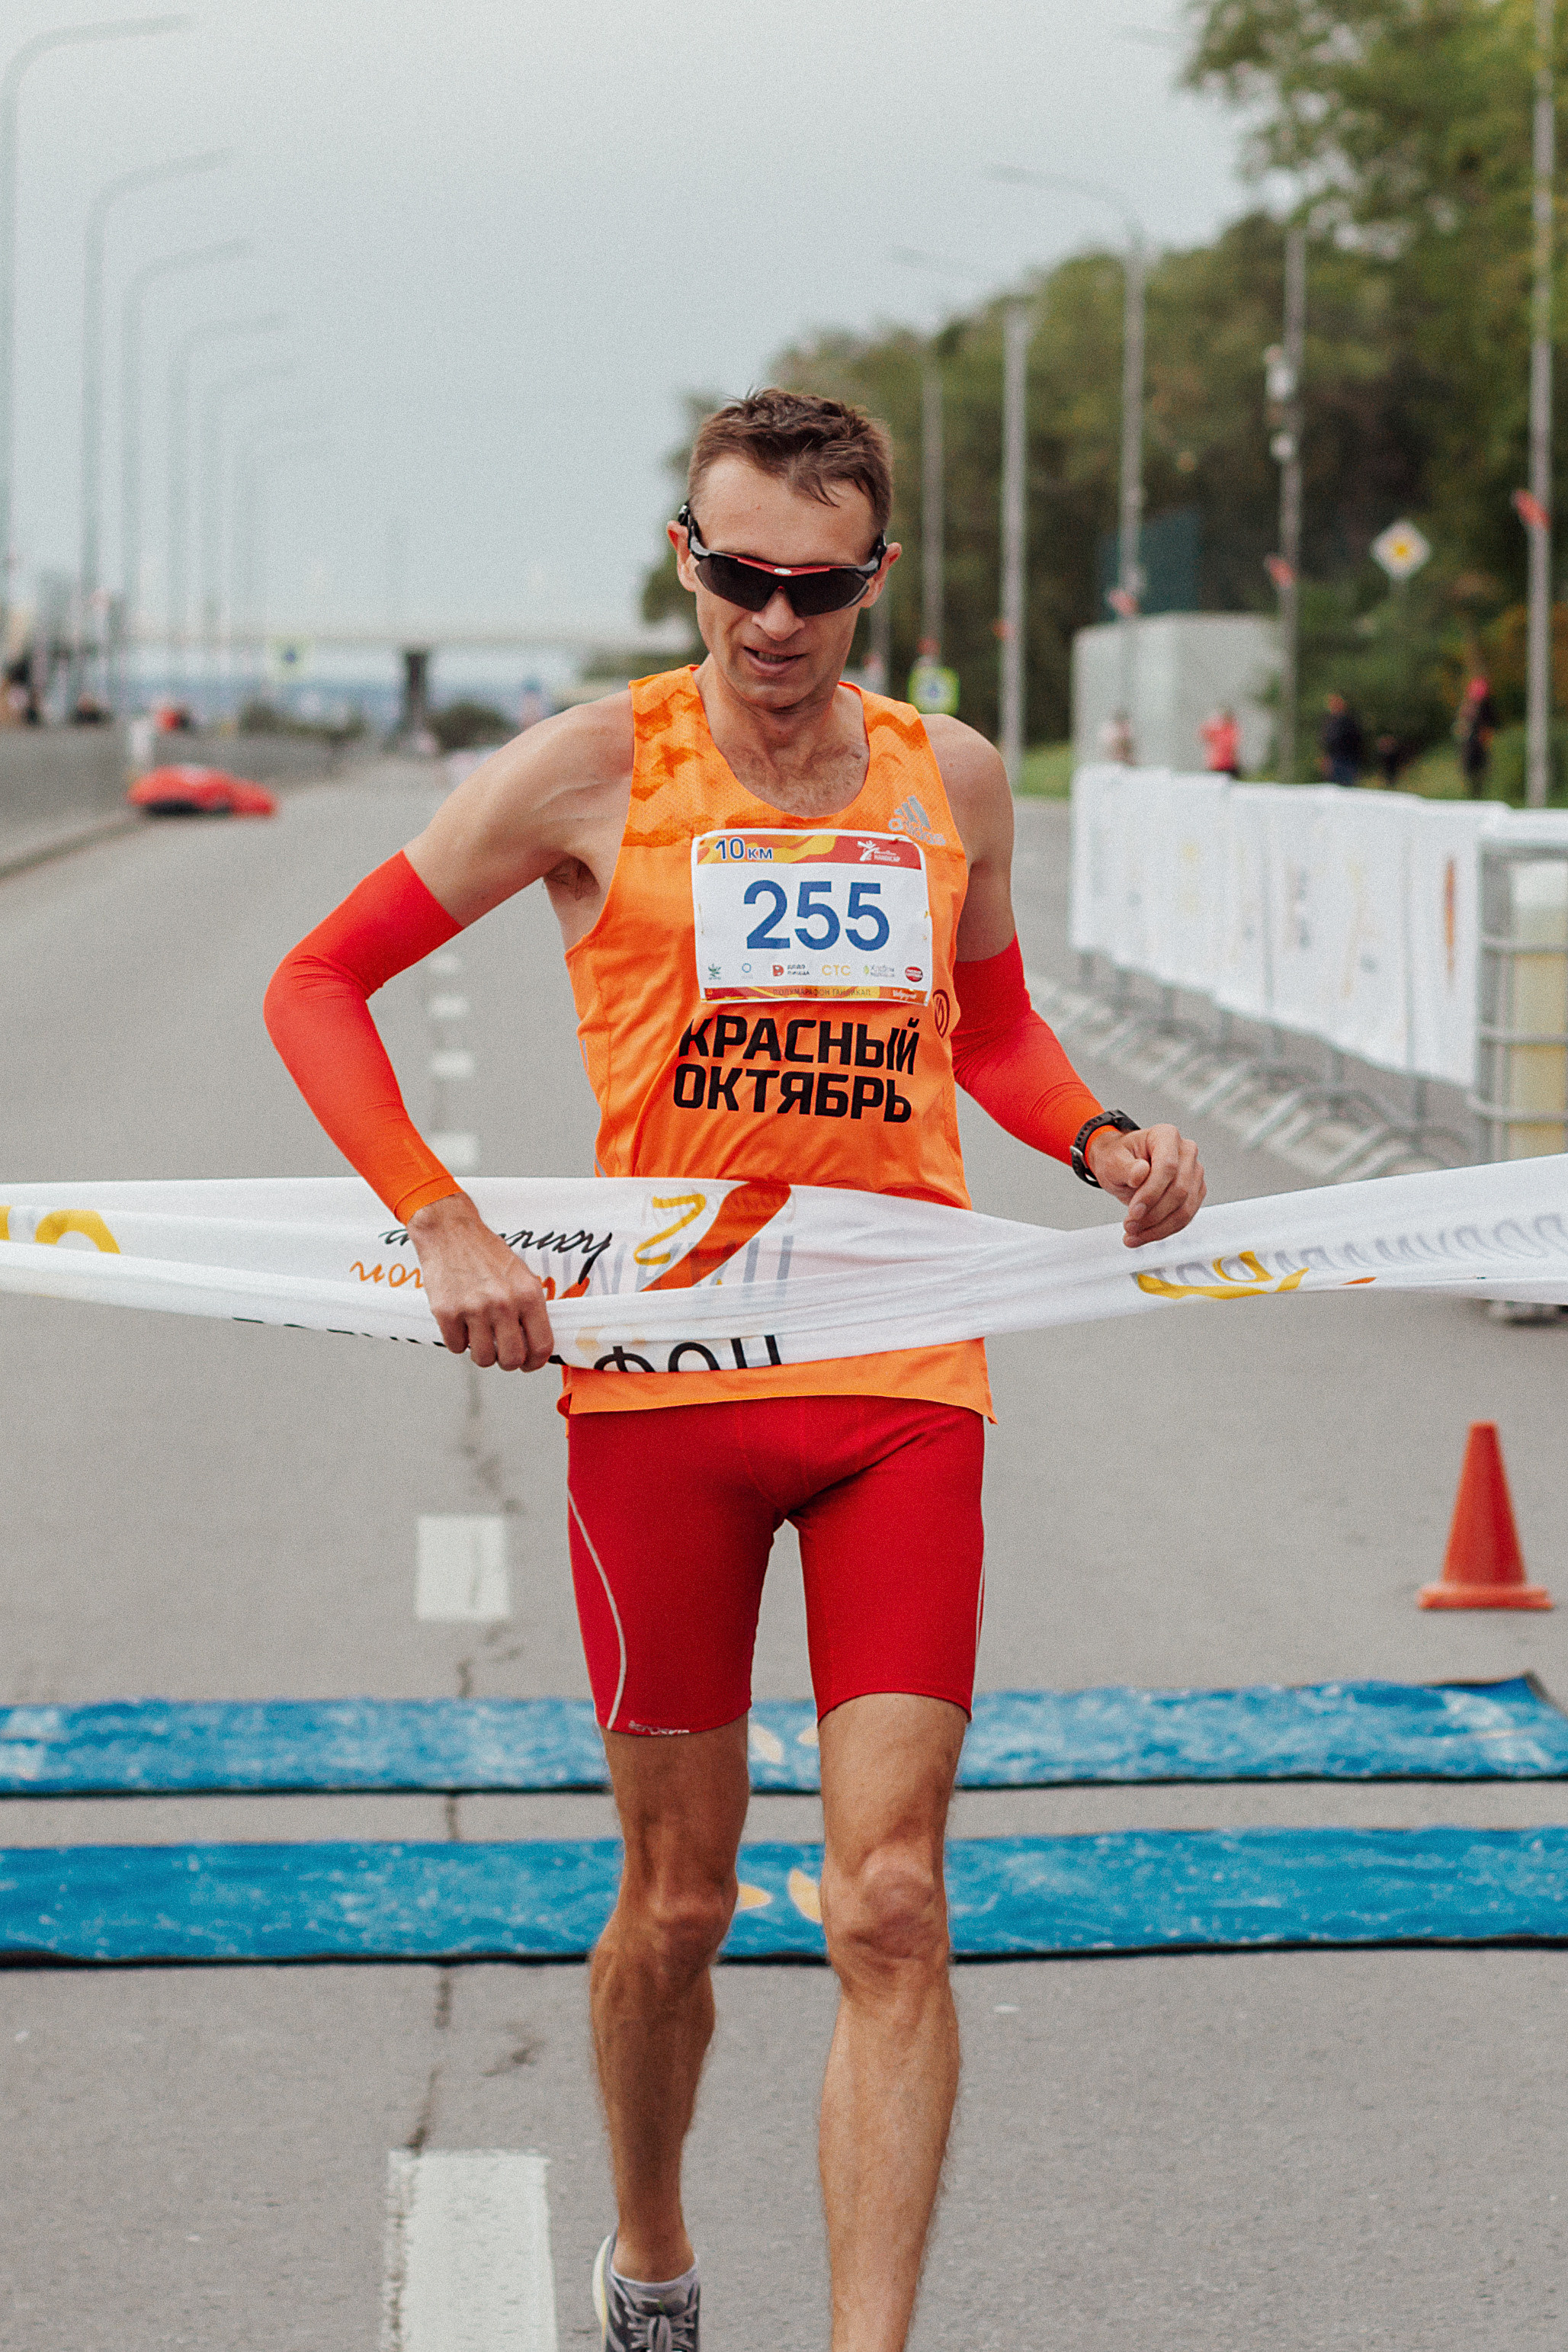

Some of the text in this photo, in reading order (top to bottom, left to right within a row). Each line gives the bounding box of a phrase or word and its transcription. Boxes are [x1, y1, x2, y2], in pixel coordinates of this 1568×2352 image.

[888, 818, 946, 846] adidas
[743, 880, 890, 951] 255
[822, 964, 851, 976] СТС
[678, 1015, 920, 1076] КРАСНЫЙ
[672, 1063, 912, 1123] ОКТЯБРЬ
